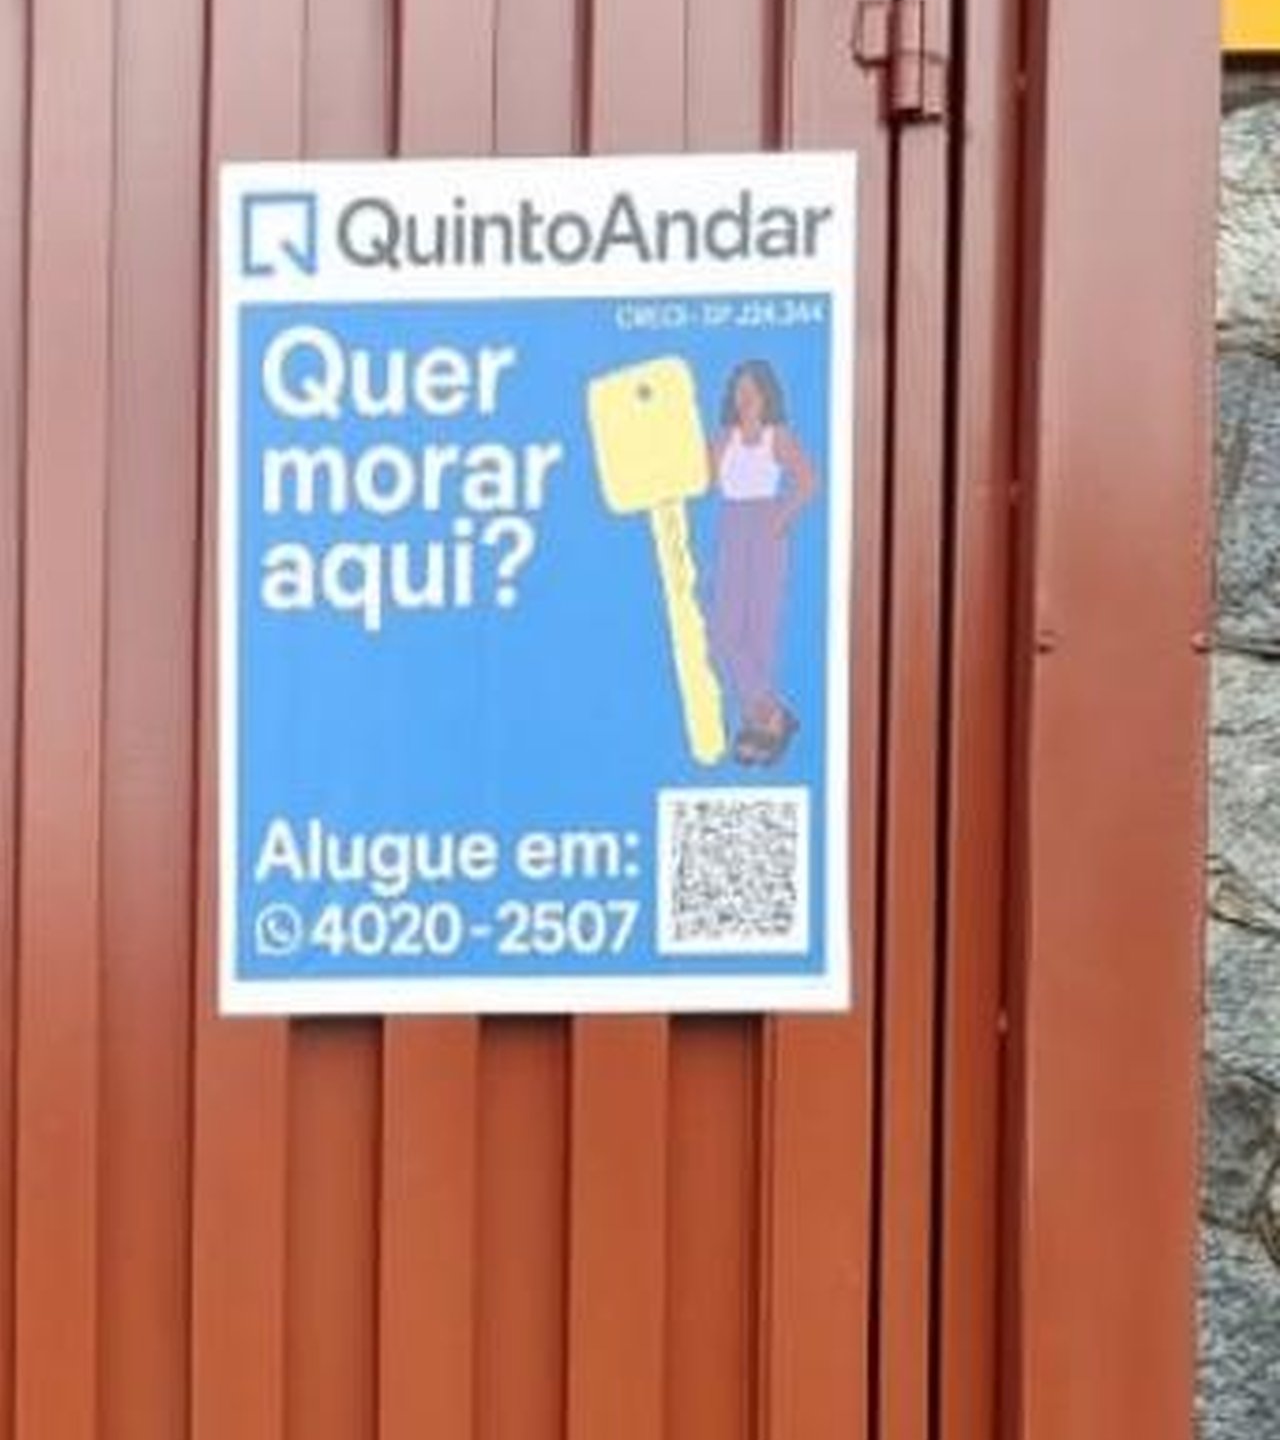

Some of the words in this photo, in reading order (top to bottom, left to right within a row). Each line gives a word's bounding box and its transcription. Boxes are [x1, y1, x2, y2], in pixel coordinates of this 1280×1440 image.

[337, 190, 833, 269] QuintoAndar
[262, 325, 517, 420] Quer
[263, 442, 563, 515] morar
[261, 516, 536, 632] aqui?
[255, 816, 499, 898] Alugue
[515, 828, 640, 879] em:
